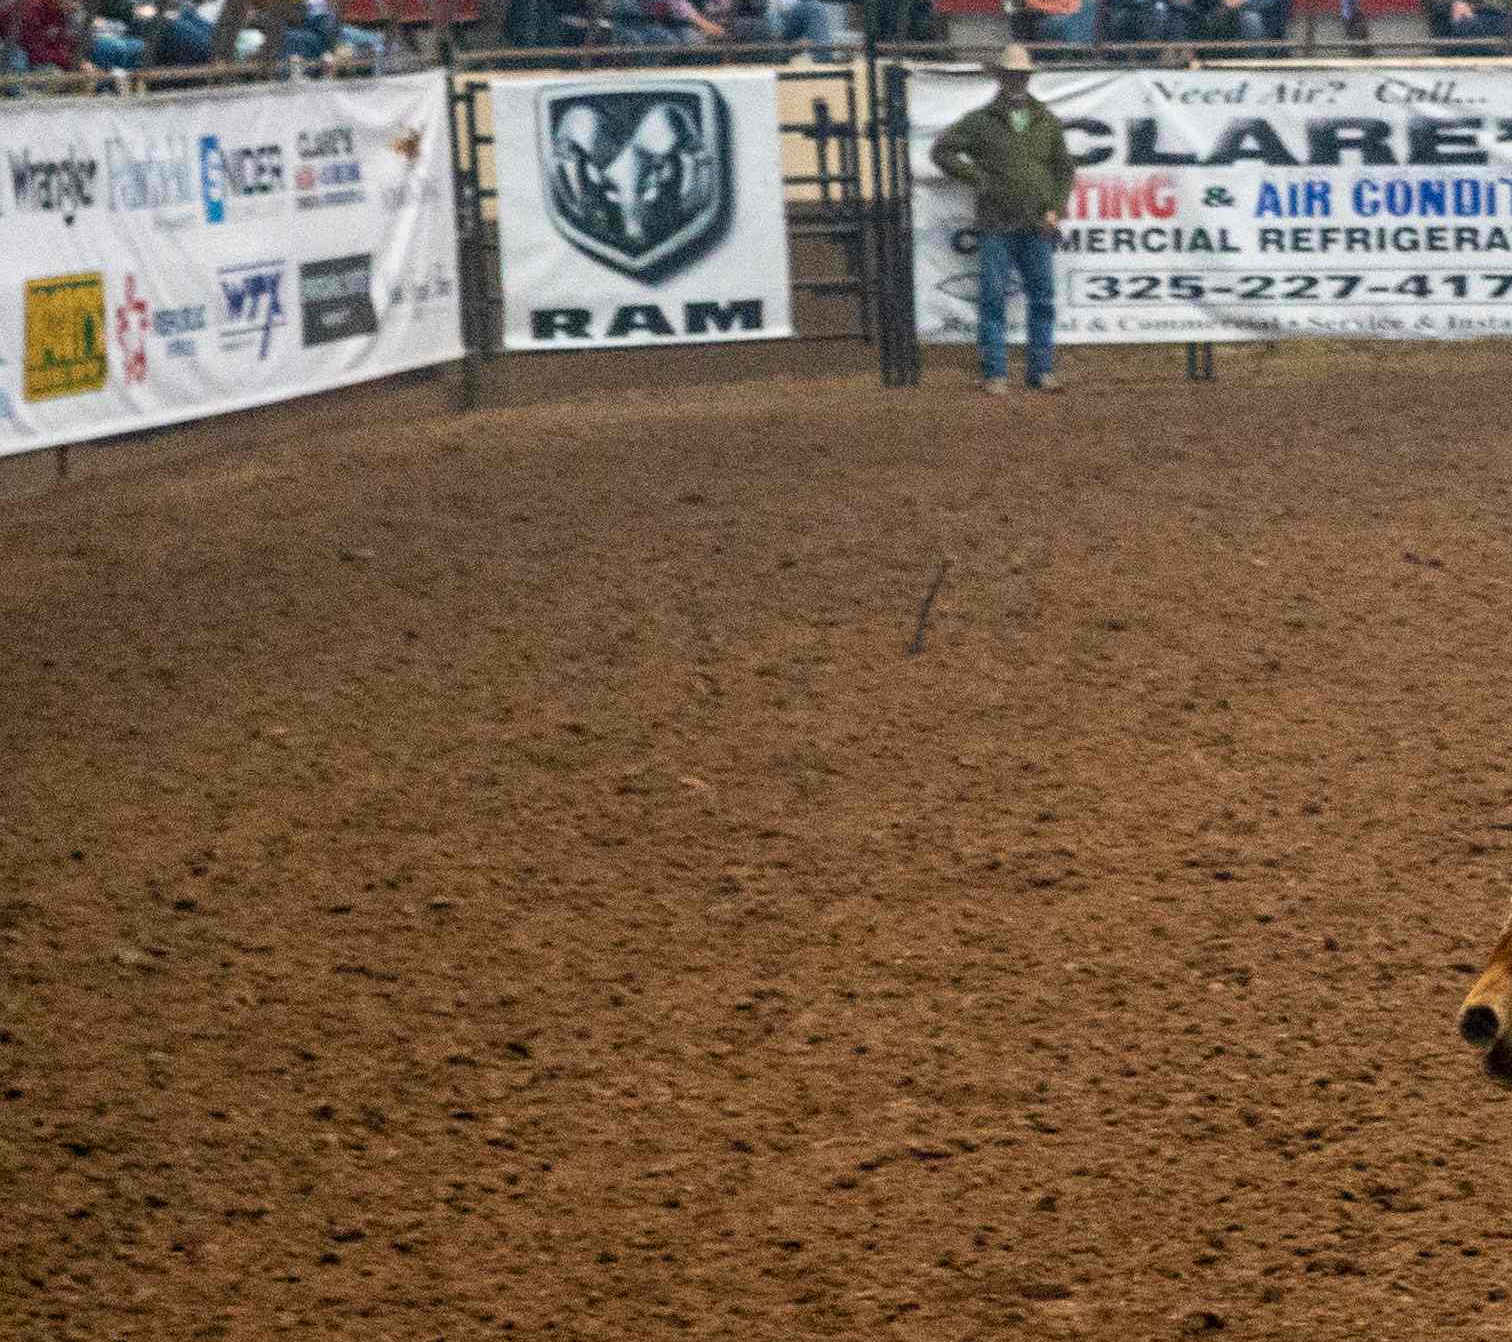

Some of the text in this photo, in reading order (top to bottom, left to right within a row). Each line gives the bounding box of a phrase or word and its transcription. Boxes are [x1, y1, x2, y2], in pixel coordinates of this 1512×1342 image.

[1144, 79, 1249, 106] Need
[1201, 186, 1237, 209] &
[1255, 177, 1332, 221] AIR
[950, 226, 1241, 255] CMERCIAL
[530, 299, 765, 341] RAM
